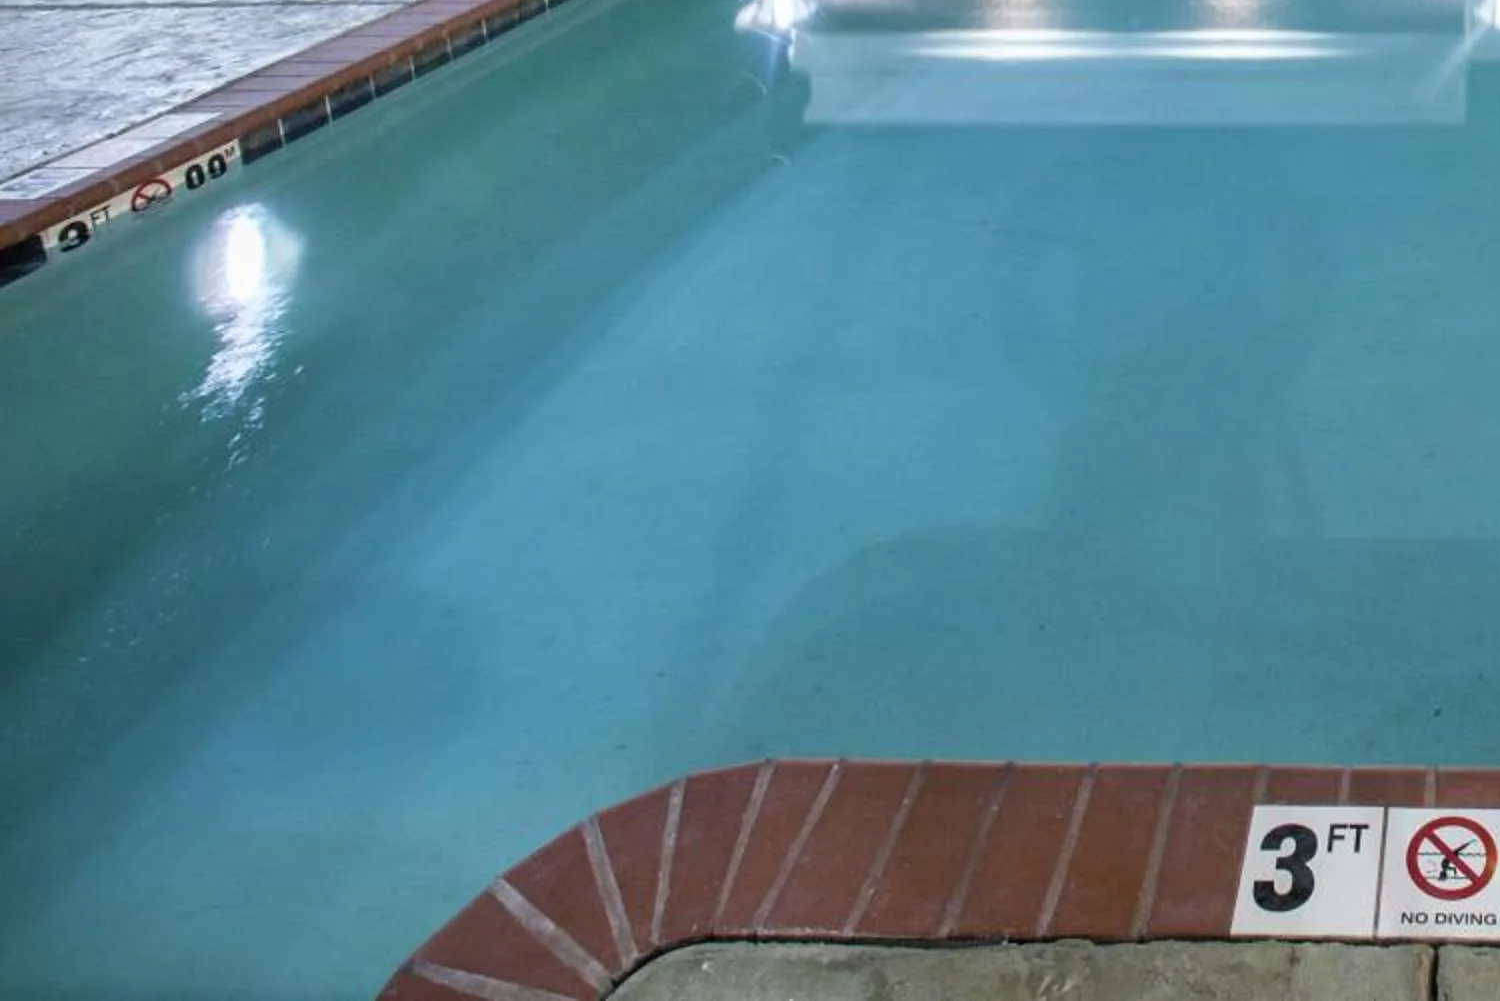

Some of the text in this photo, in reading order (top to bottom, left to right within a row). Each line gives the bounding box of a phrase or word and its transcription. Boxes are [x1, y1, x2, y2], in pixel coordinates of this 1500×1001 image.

[1252, 822, 1370, 913] 3 FT
[1401, 911, 1498, 926] NO DIVING
